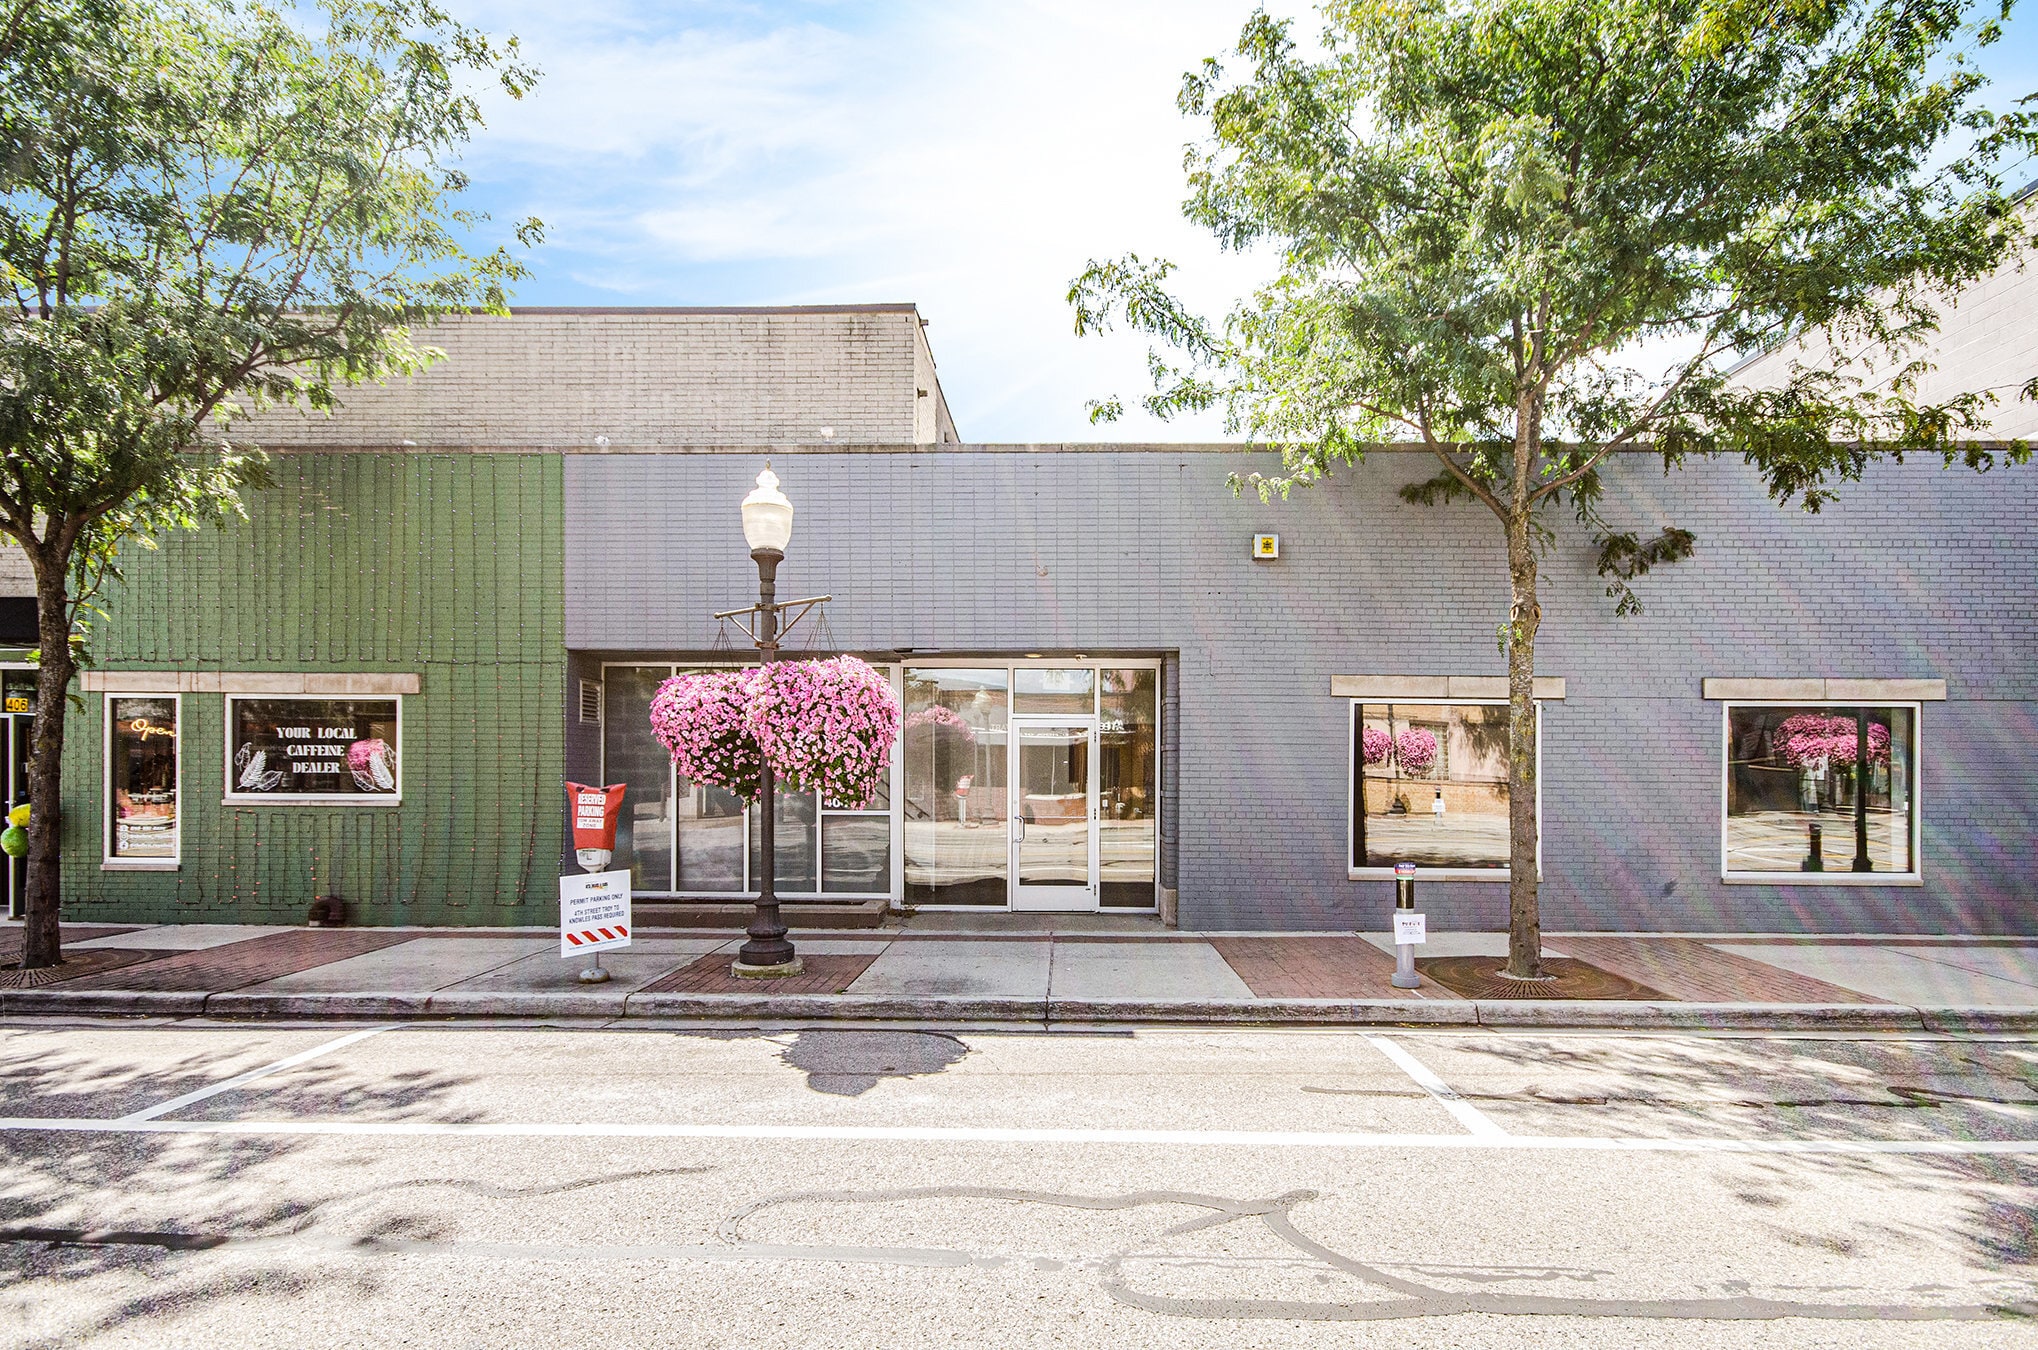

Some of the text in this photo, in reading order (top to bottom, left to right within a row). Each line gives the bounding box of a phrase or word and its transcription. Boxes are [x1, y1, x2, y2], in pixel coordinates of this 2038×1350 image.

[7, 699, 28, 711] 406
[131, 719, 176, 741] Open
[276, 727, 357, 739] YOUR LOCAL
[286, 744, 345, 756] CAFFEINE
[292, 762, 340, 774] DEALER
[577, 793, 606, 805] RESERVED
[577, 805, 605, 817] PARKING
[569, 893, 623, 906] PERMIT PARKING ONLY
[584, 907, 601, 916] STREET
